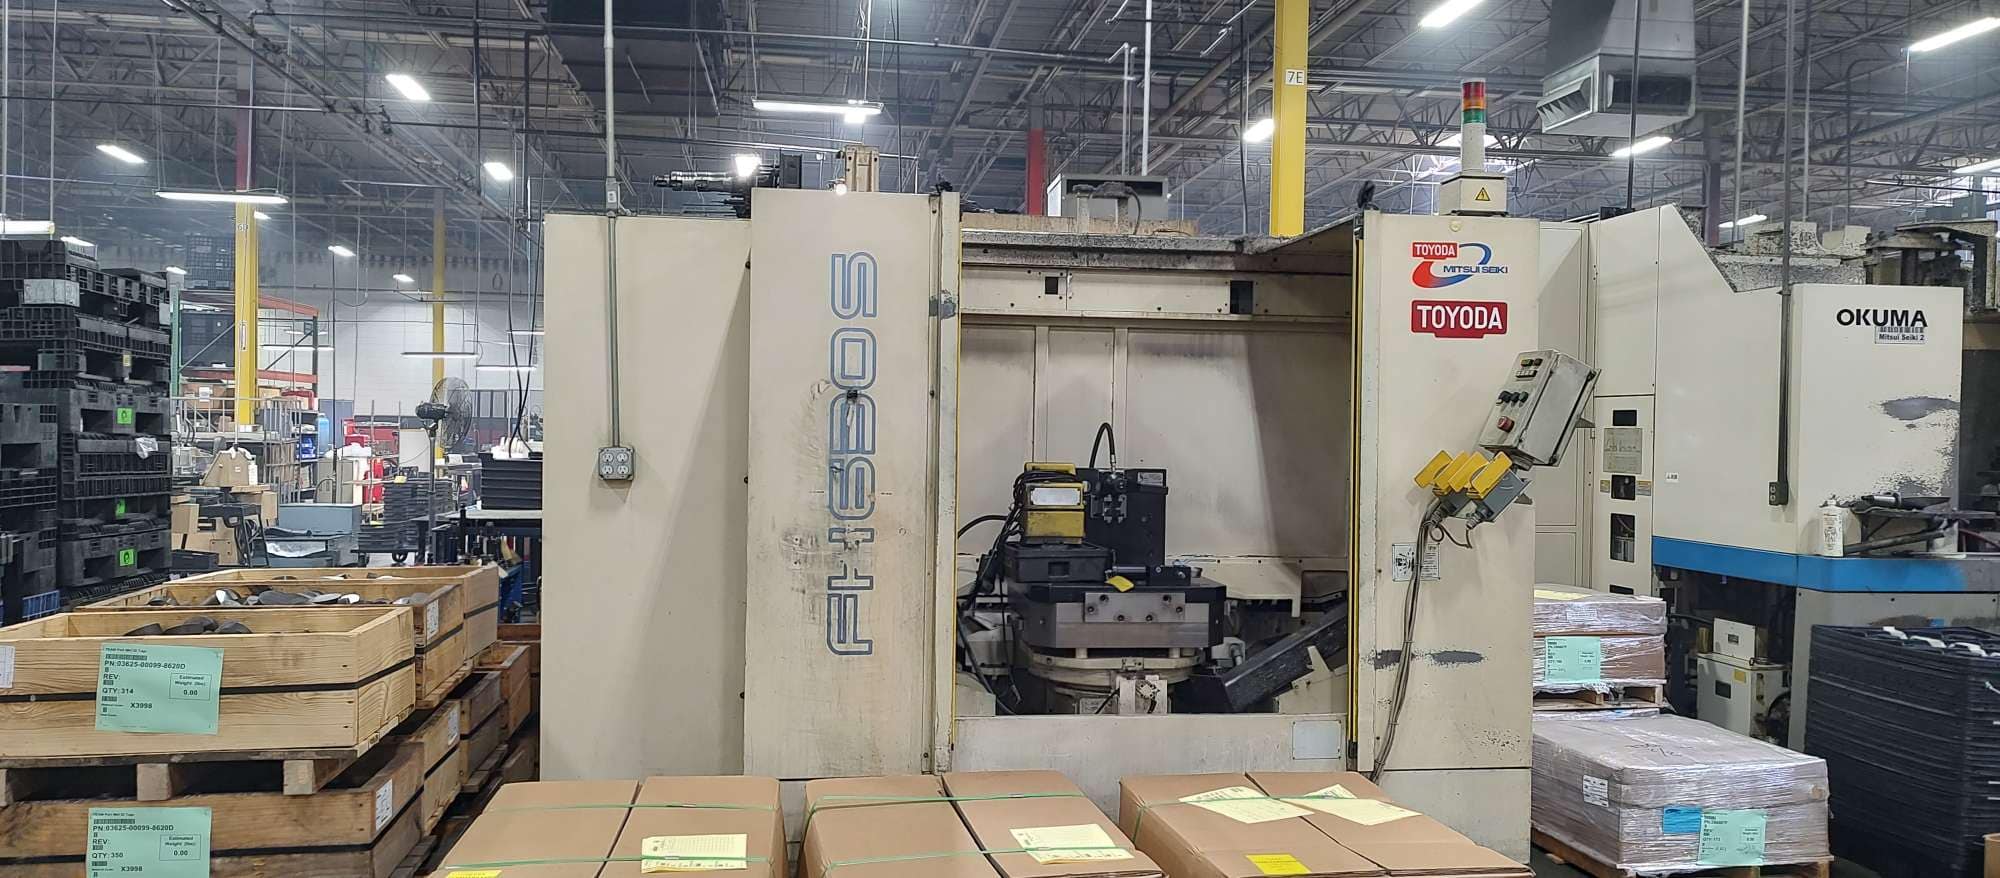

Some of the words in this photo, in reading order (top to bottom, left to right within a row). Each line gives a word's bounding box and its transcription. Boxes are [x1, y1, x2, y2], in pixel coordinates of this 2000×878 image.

[1287, 71, 1303, 84] 7E
[1414, 244, 1456, 256] TOYODA
[1443, 265, 1481, 273] MITSUI
[1482, 266, 1508, 274] SEIKI
[1416, 305, 1503, 330] TOYODA
[1836, 308, 1928, 327] OKUMA
[1879, 333, 1900, 341] Mitsui
[826, 251, 878, 656] FH630S
[103, 673, 121, 681] REV:
[102, 687, 120, 695] QTY:
